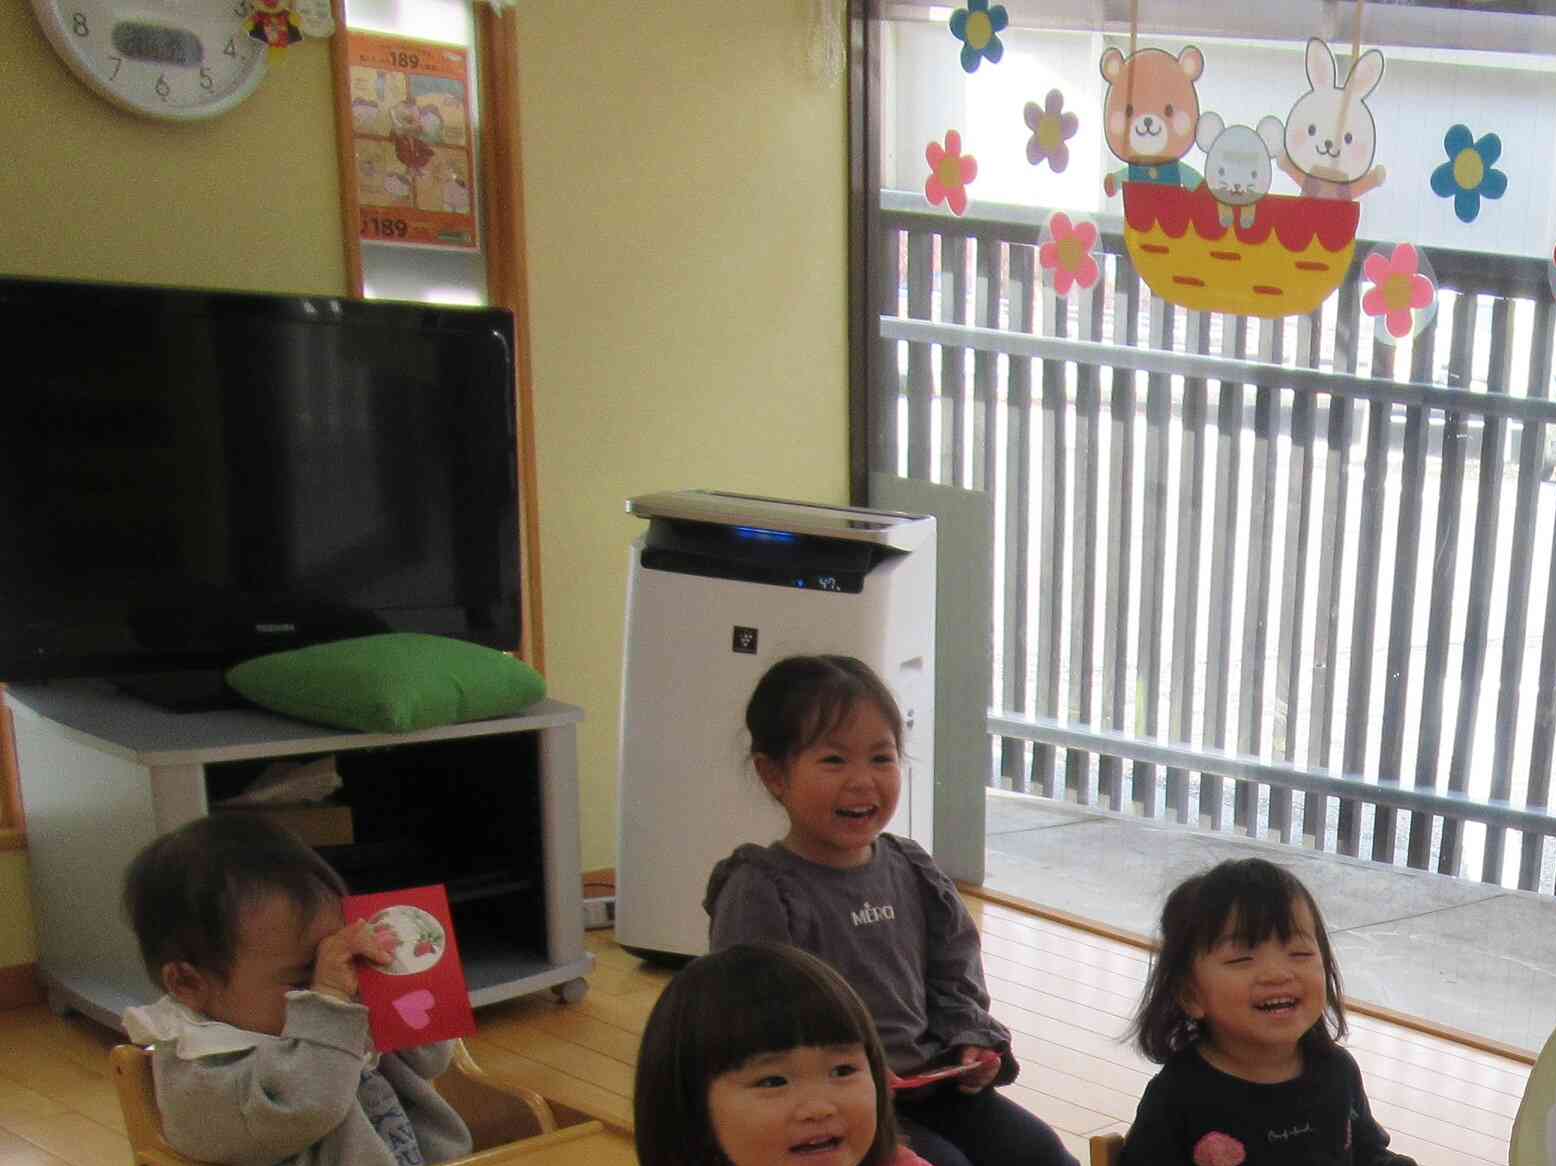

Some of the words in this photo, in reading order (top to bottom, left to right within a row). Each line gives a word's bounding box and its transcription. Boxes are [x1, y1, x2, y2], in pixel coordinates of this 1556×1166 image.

[72, 12, 89, 38] 8
[223, 40, 236, 59] 4
[389, 51, 420, 68] 189
[109, 56, 123, 81] 7
[199, 68, 213, 90] 5
[155, 75, 170, 97] 6
[373, 216, 408, 238] 189
